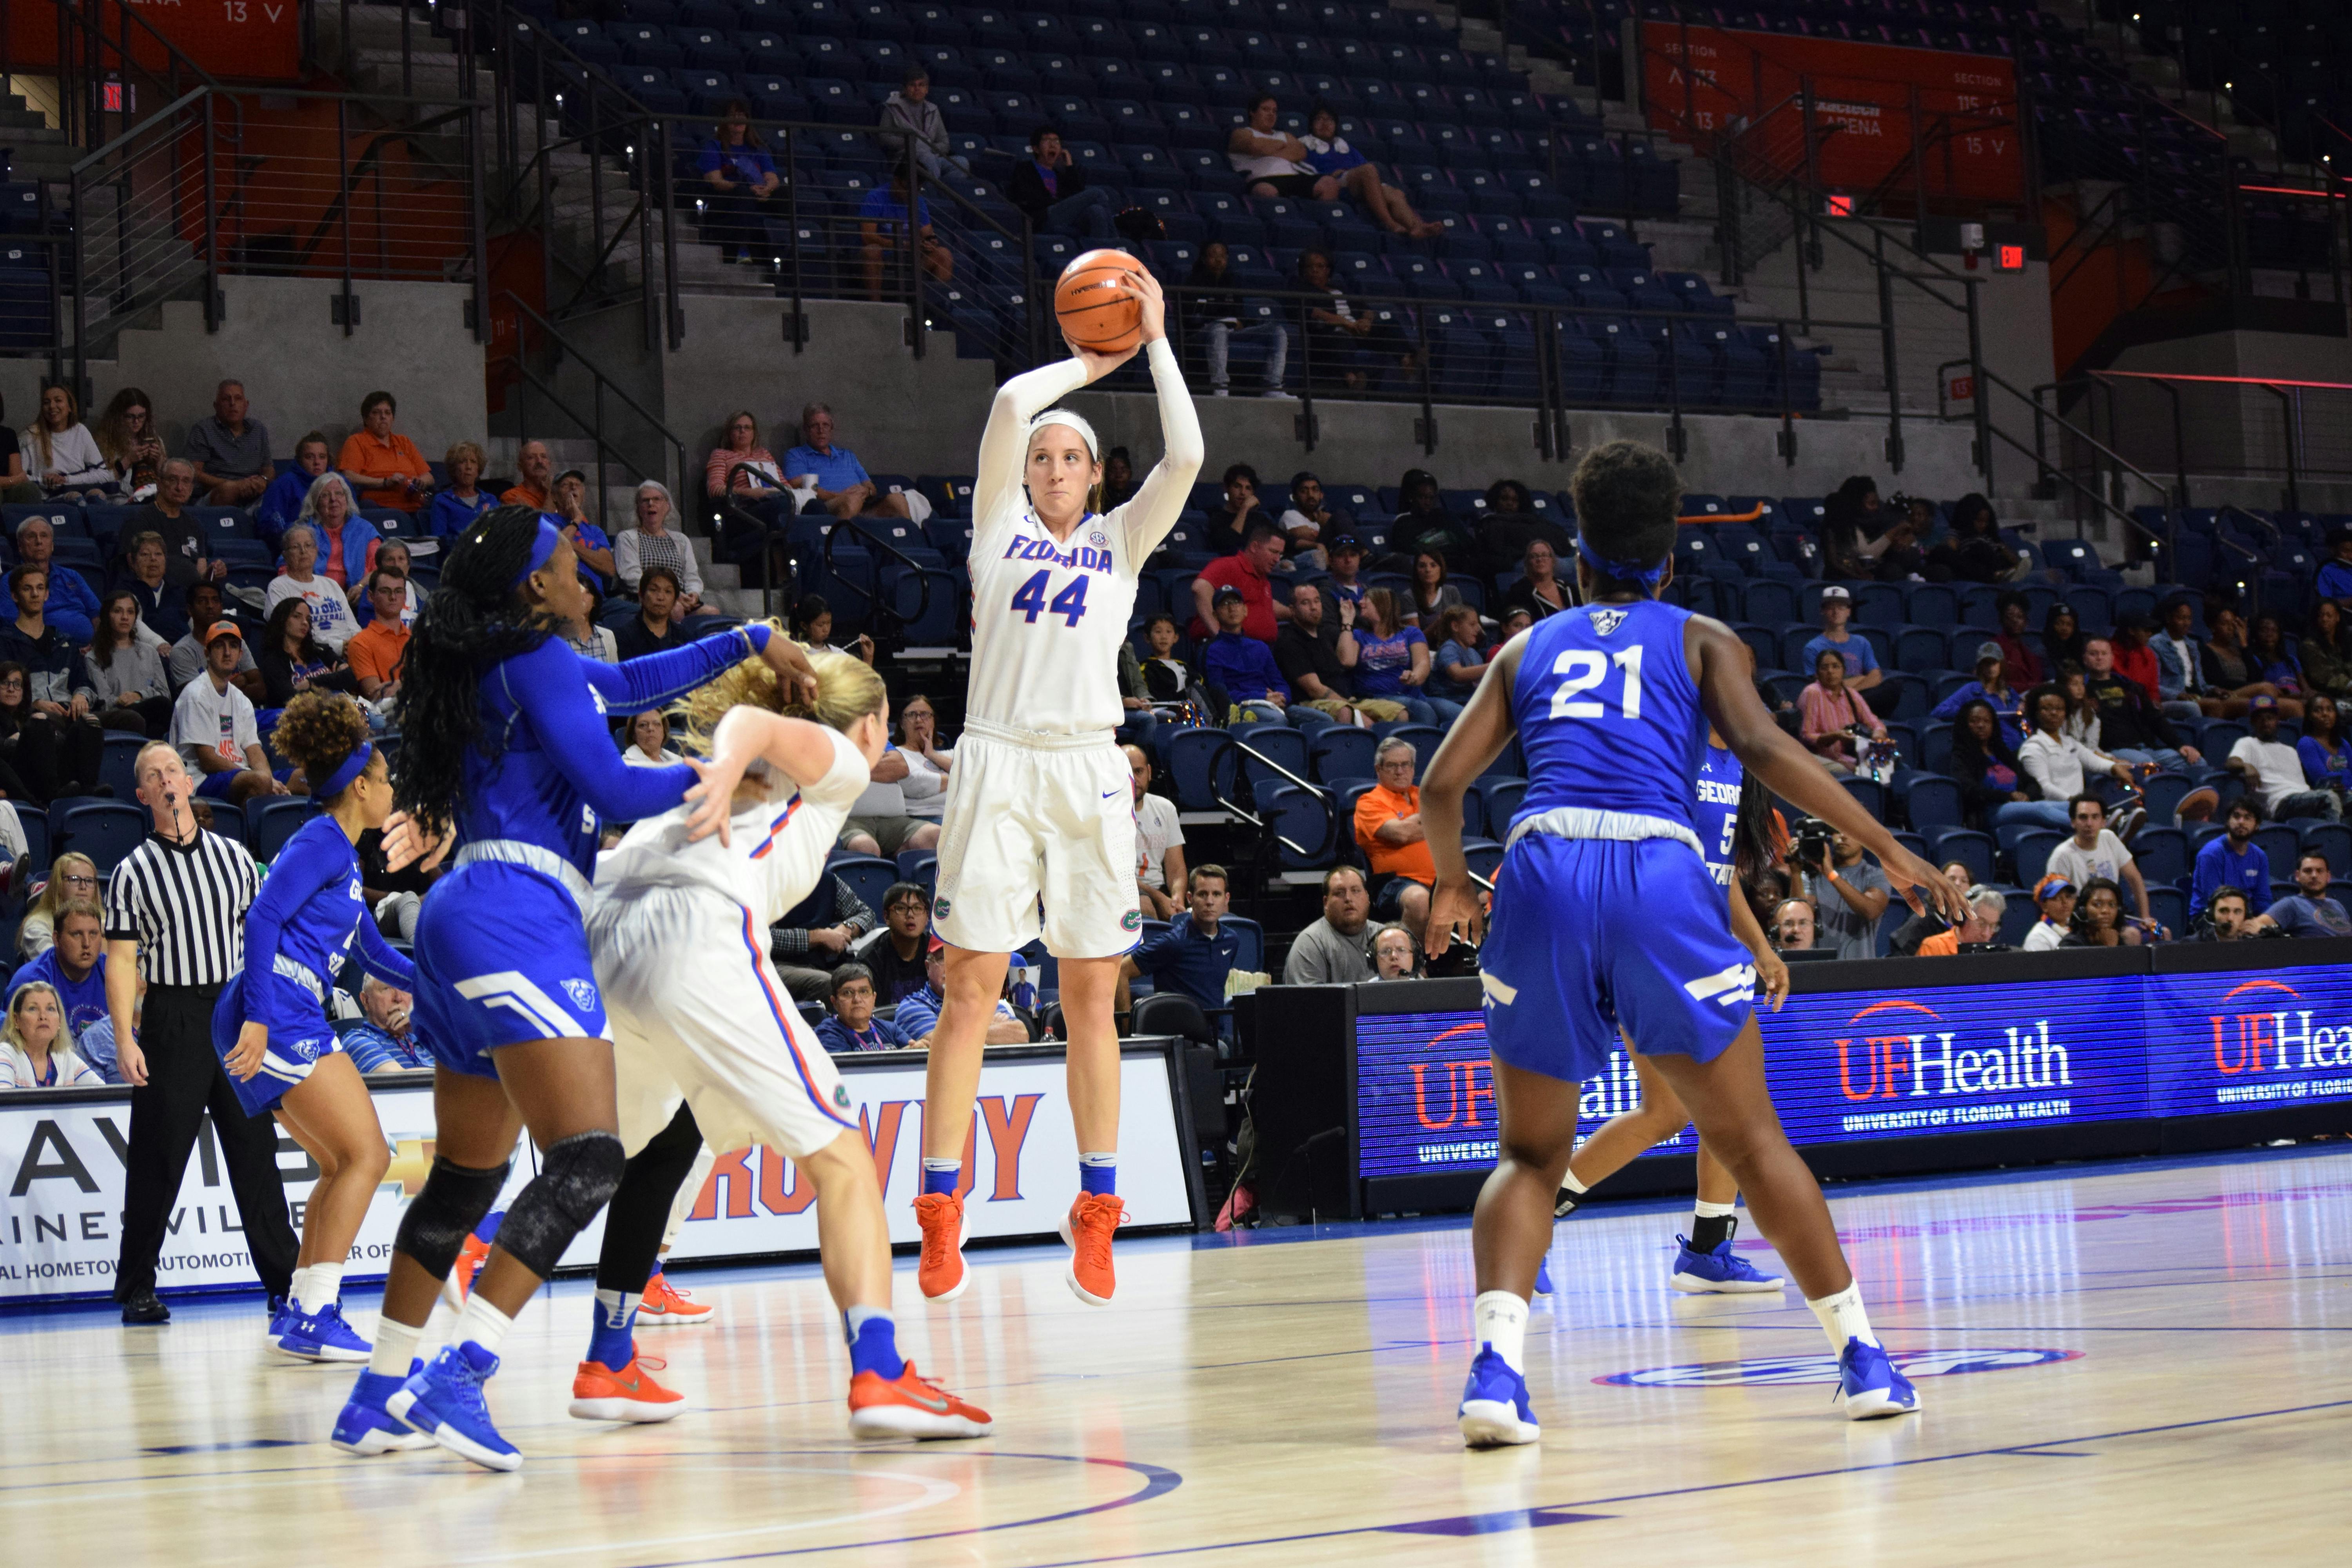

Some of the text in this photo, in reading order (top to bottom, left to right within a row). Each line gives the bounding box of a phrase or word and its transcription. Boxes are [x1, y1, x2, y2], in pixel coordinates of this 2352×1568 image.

[223, 1, 247, 22] 13
[1665, 42, 1717, 58] SETION
[1954, 73, 2002, 87] SECTION
[1696, 112, 1714, 130] 13
[1966, 137, 1983, 155] 15
[1091, 532, 1104, 544] SEC
[1002, 534, 1112, 575] FLORIDA
[1011, 569, 1090, 628] 44
[1549, 645, 1643, 721] 21
[1720, 813, 1738, 855] 5
[1705, 862, 1736, 885] TAT
[2216, 1084, 2291, 1103] UNIVERSITY
[2292, 1082, 2308, 1097] OF
[1843, 1099, 2071, 1132] UNIVERSITY OF FLORIDA HEALTH
